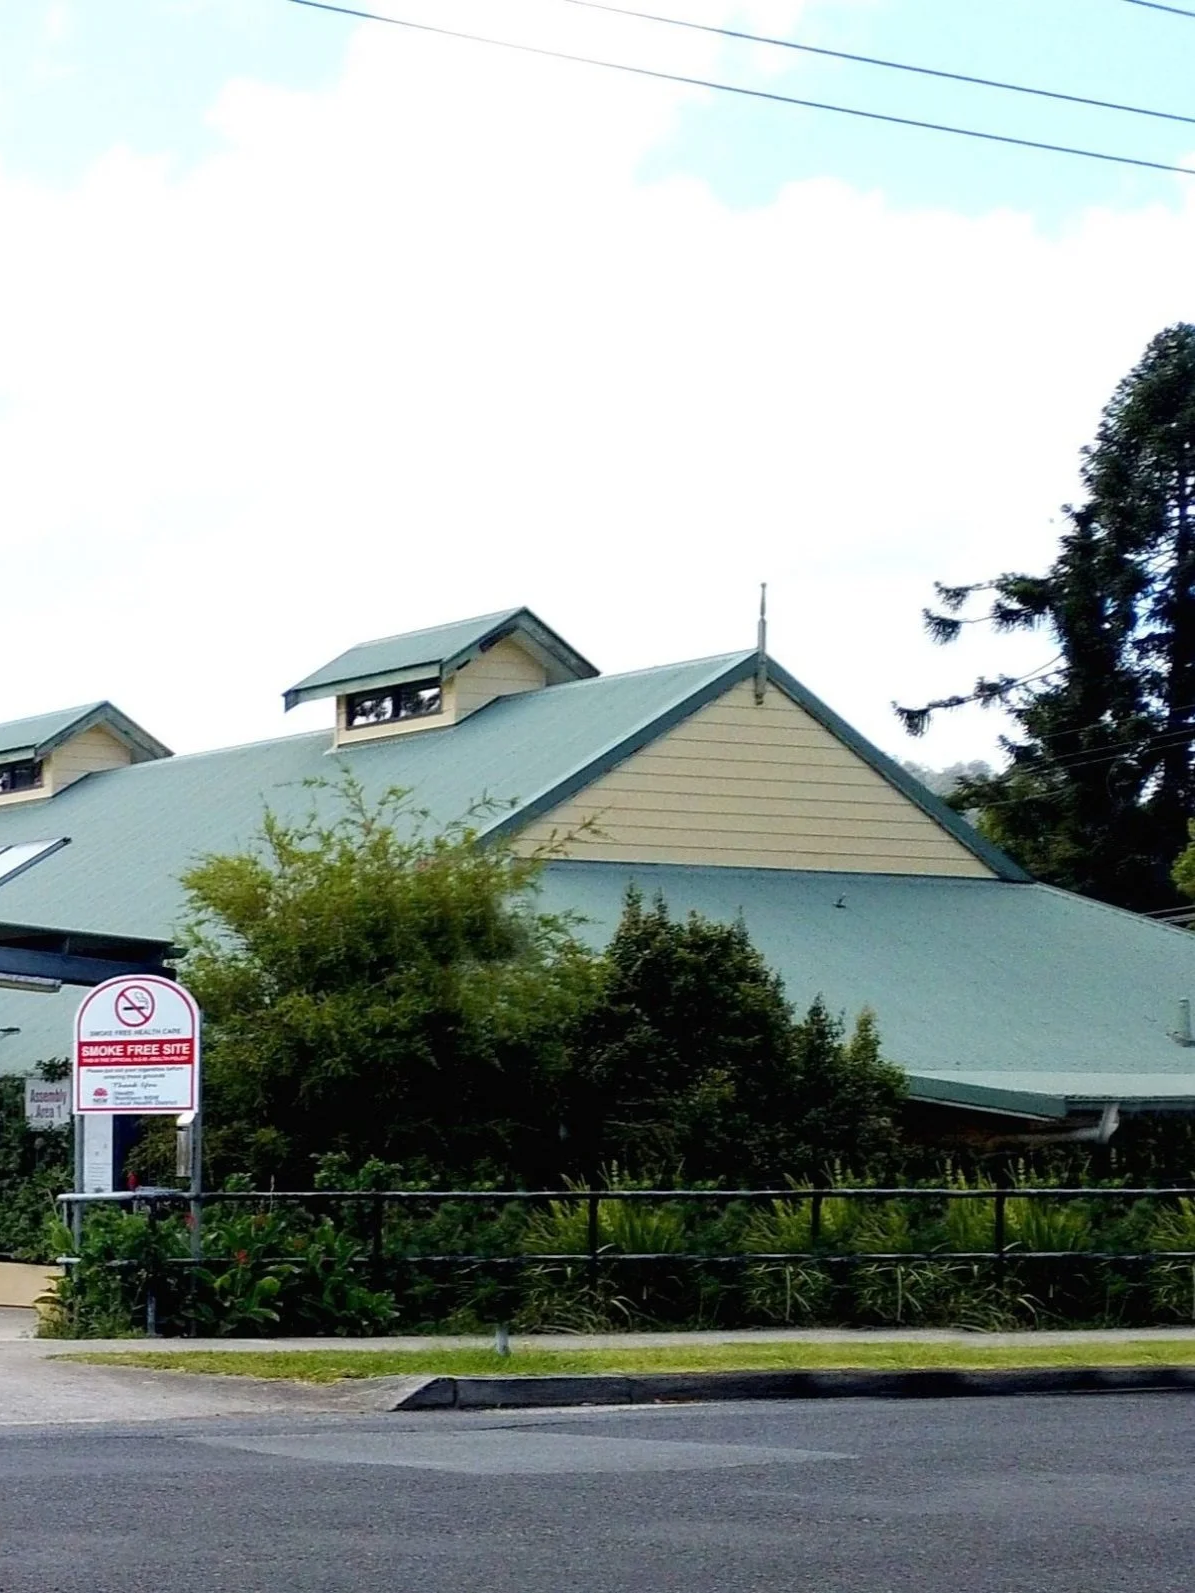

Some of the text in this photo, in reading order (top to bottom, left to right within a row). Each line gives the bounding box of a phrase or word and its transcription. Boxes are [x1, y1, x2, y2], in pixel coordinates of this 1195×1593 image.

[134, 1028, 161, 1036] HEALTH
[81, 1043, 191, 1057] SMOKE FREE SITE
[30, 1089, 67, 1105] Assembly
[36, 1104, 55, 1119] Area
